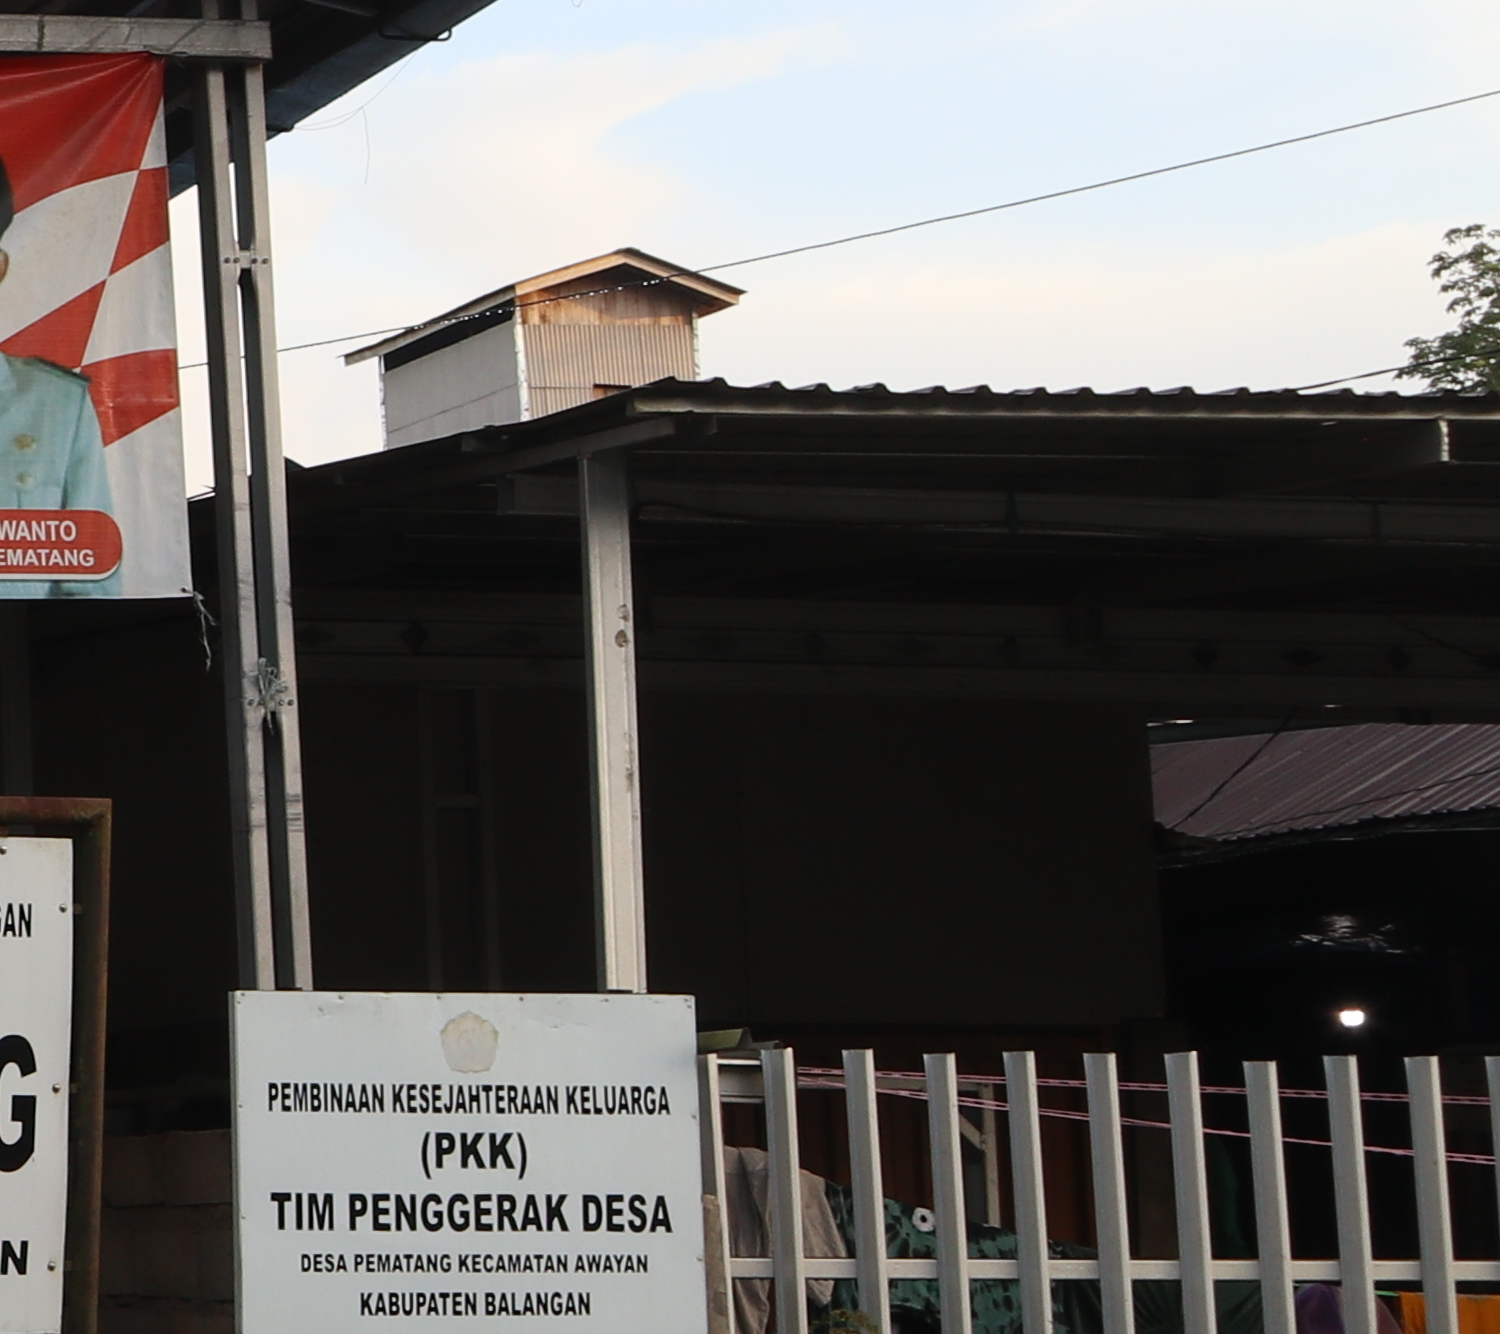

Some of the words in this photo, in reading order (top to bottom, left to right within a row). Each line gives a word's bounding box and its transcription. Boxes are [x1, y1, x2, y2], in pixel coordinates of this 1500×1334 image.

[268, 1083, 384, 1113] PEMBINAAN
[392, 1084, 559, 1115] KESEJAHTERAAN
[566, 1086, 670, 1116] KELUARGA
[421, 1132, 527, 1179] (PKK)
[271, 1192, 334, 1232] TIM
[349, 1193, 570, 1233] PENGGERAK
[582, 1195, 673, 1234] DESA
[300, 1254, 348, 1273] DESA
[353, 1254, 452, 1274] PEMATANG
[458, 1254, 568, 1274] KECAMATAN
[574, 1255, 648, 1274] AWAYAN
[360, 1292, 477, 1316] KABUPATEN
[485, 1292, 591, 1316] BALANGAN
